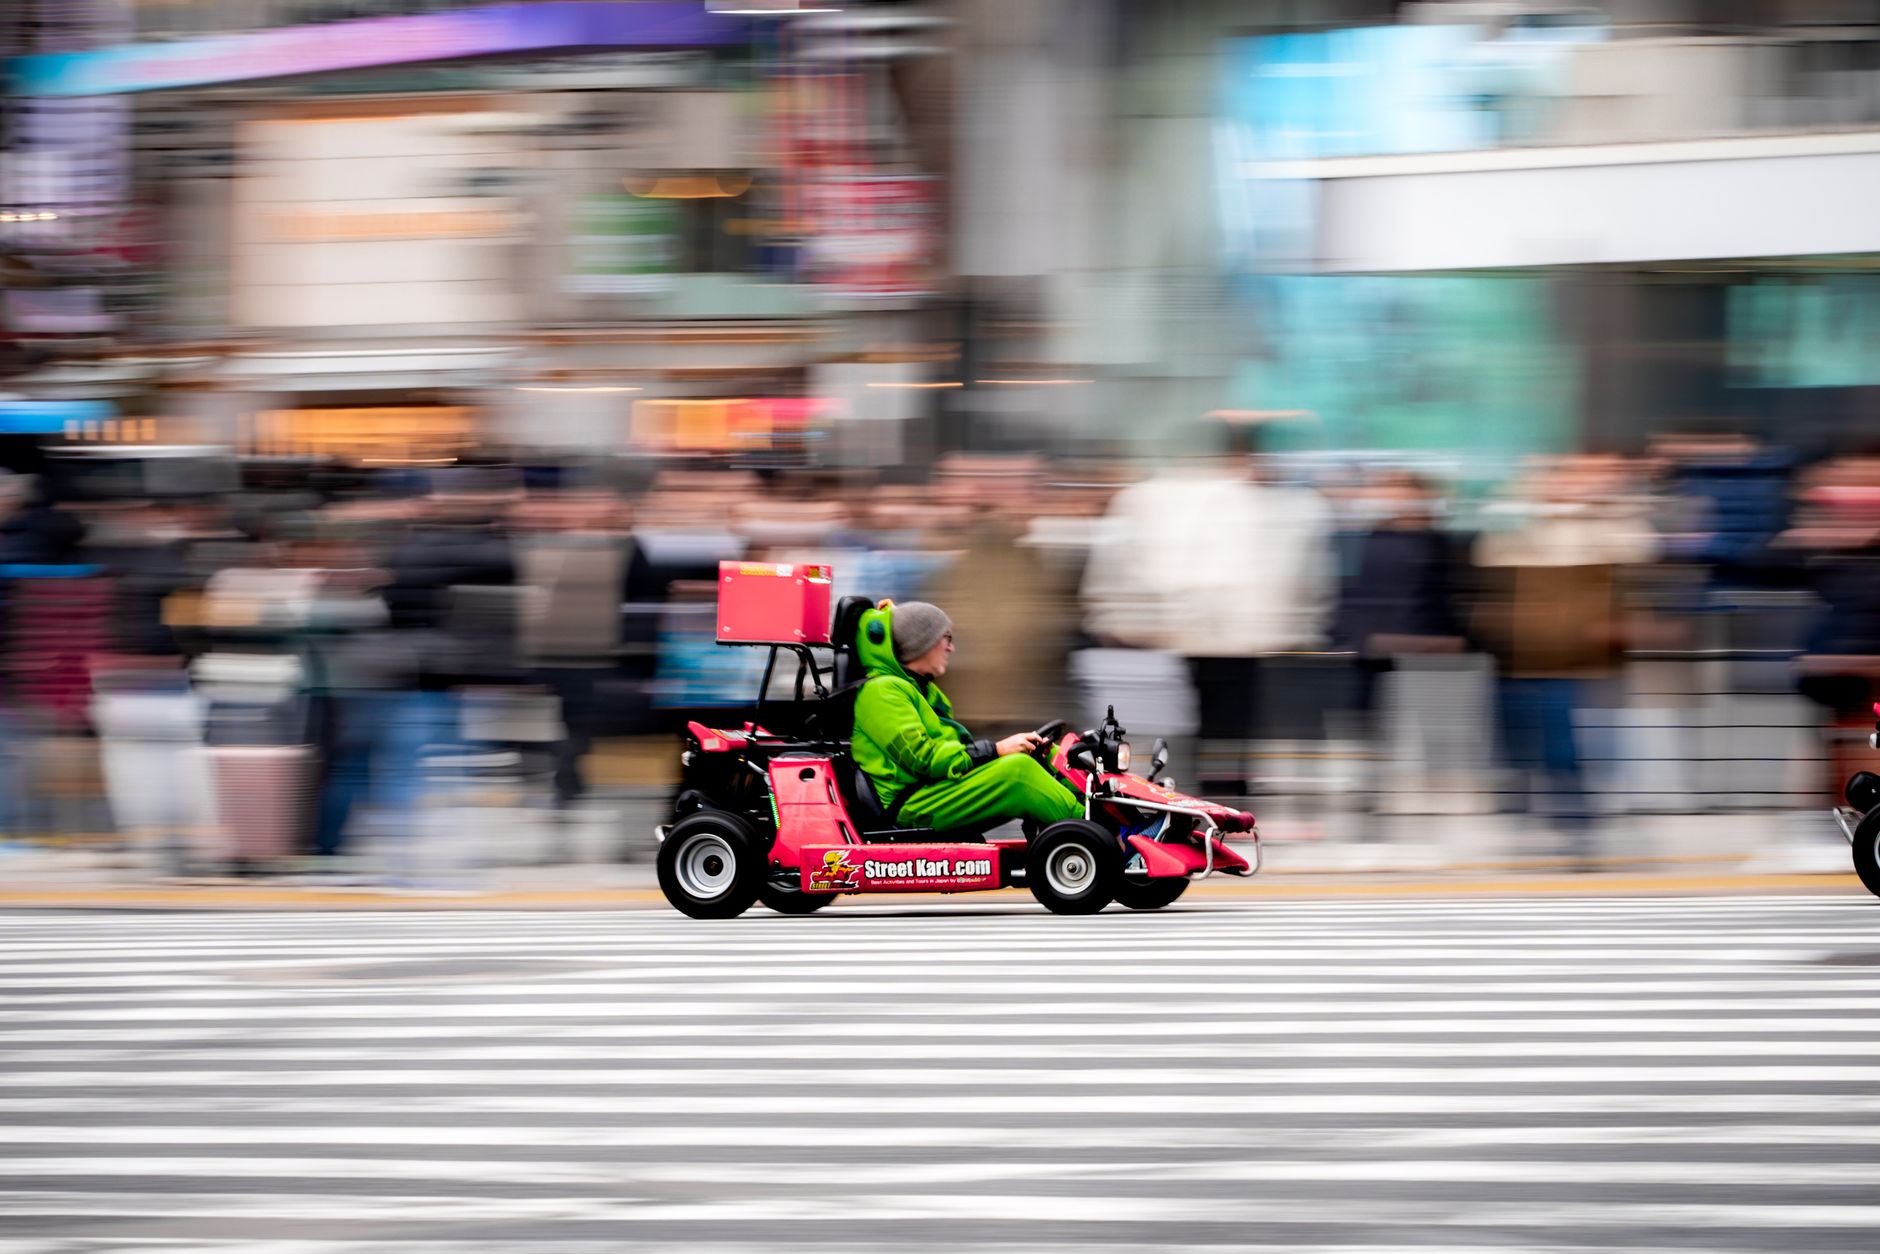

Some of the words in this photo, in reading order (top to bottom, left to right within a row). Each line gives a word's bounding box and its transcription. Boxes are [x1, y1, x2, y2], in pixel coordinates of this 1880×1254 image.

[864, 860, 914, 878] Street
[916, 859, 949, 876] Kart
[952, 860, 991, 876] .com
